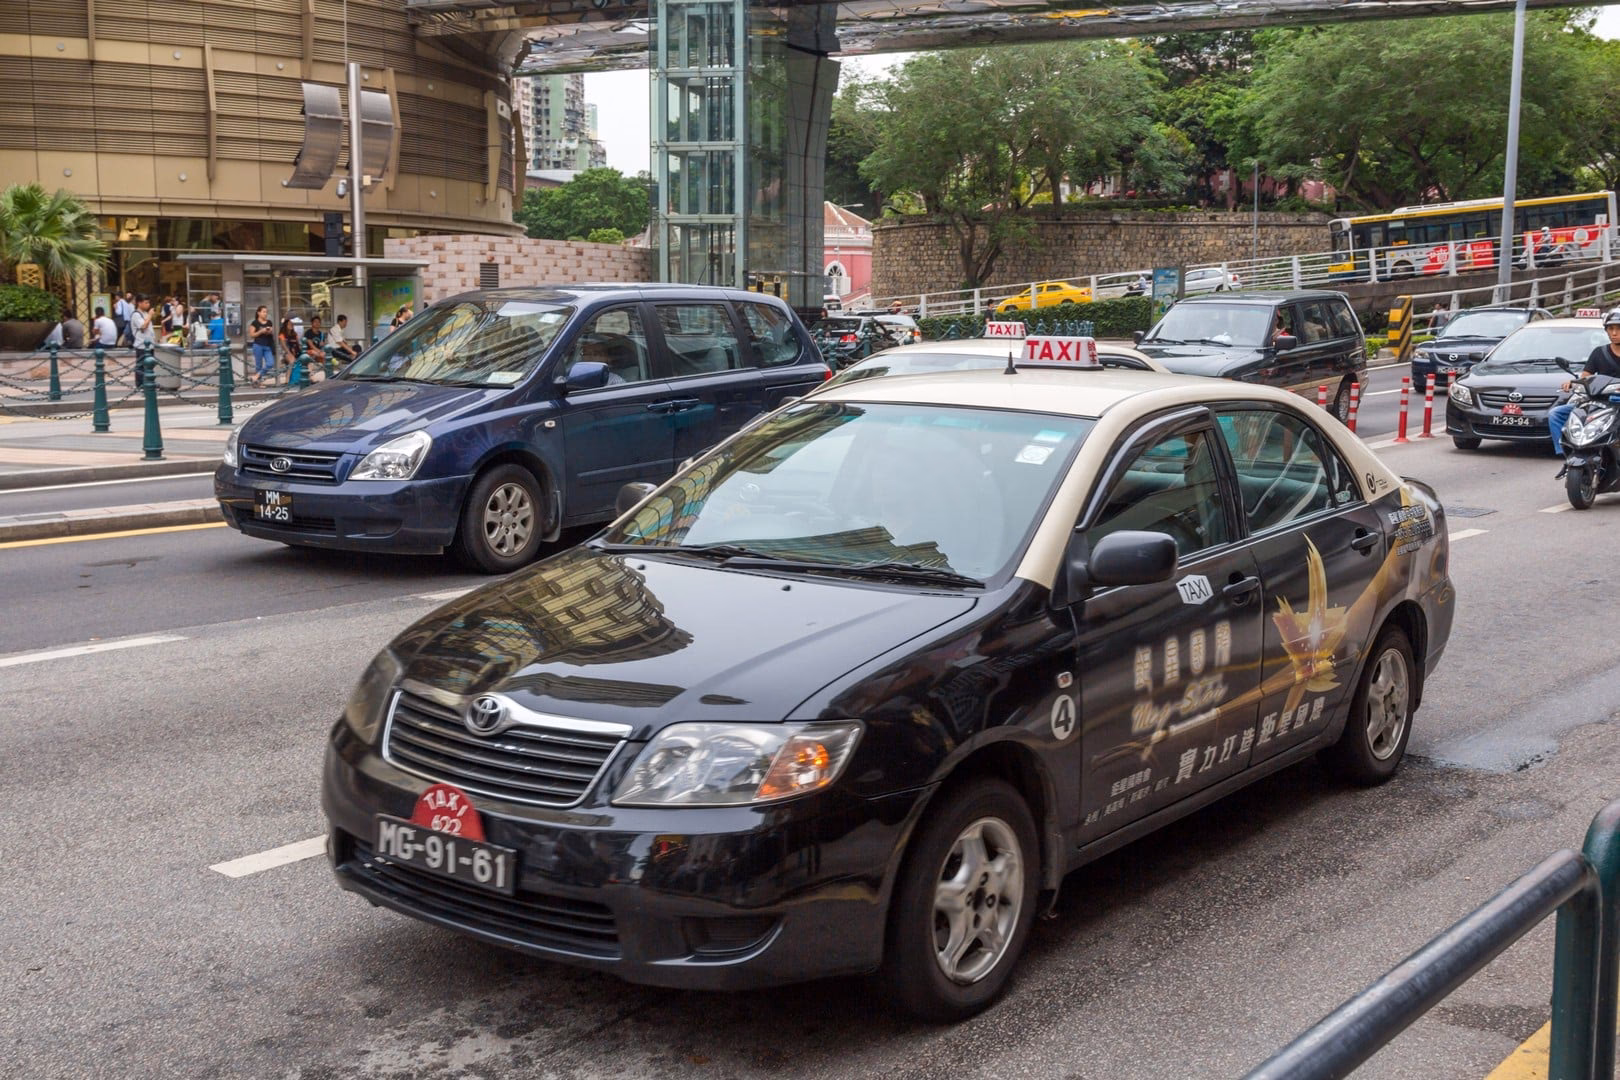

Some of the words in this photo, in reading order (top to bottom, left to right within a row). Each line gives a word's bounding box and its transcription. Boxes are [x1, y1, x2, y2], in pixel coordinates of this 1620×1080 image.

[988, 324, 1017, 336] TAXI
[1026, 340, 1082, 361] TAXI
[1087, 340, 1097, 363] 的士
[1492, 416, 1530, 426] M-23-94
[273, 459, 289, 469] KIA
[265, 491, 280, 505] MM
[259, 505, 289, 521] 14-25
[1178, 579, 1209, 602] TAXI
[1054, 698, 1072, 732] 4
[423, 789, 468, 817] TAXI
[431, 814, 463, 836] 622
[378, 820, 506, 888] MG-91-61
